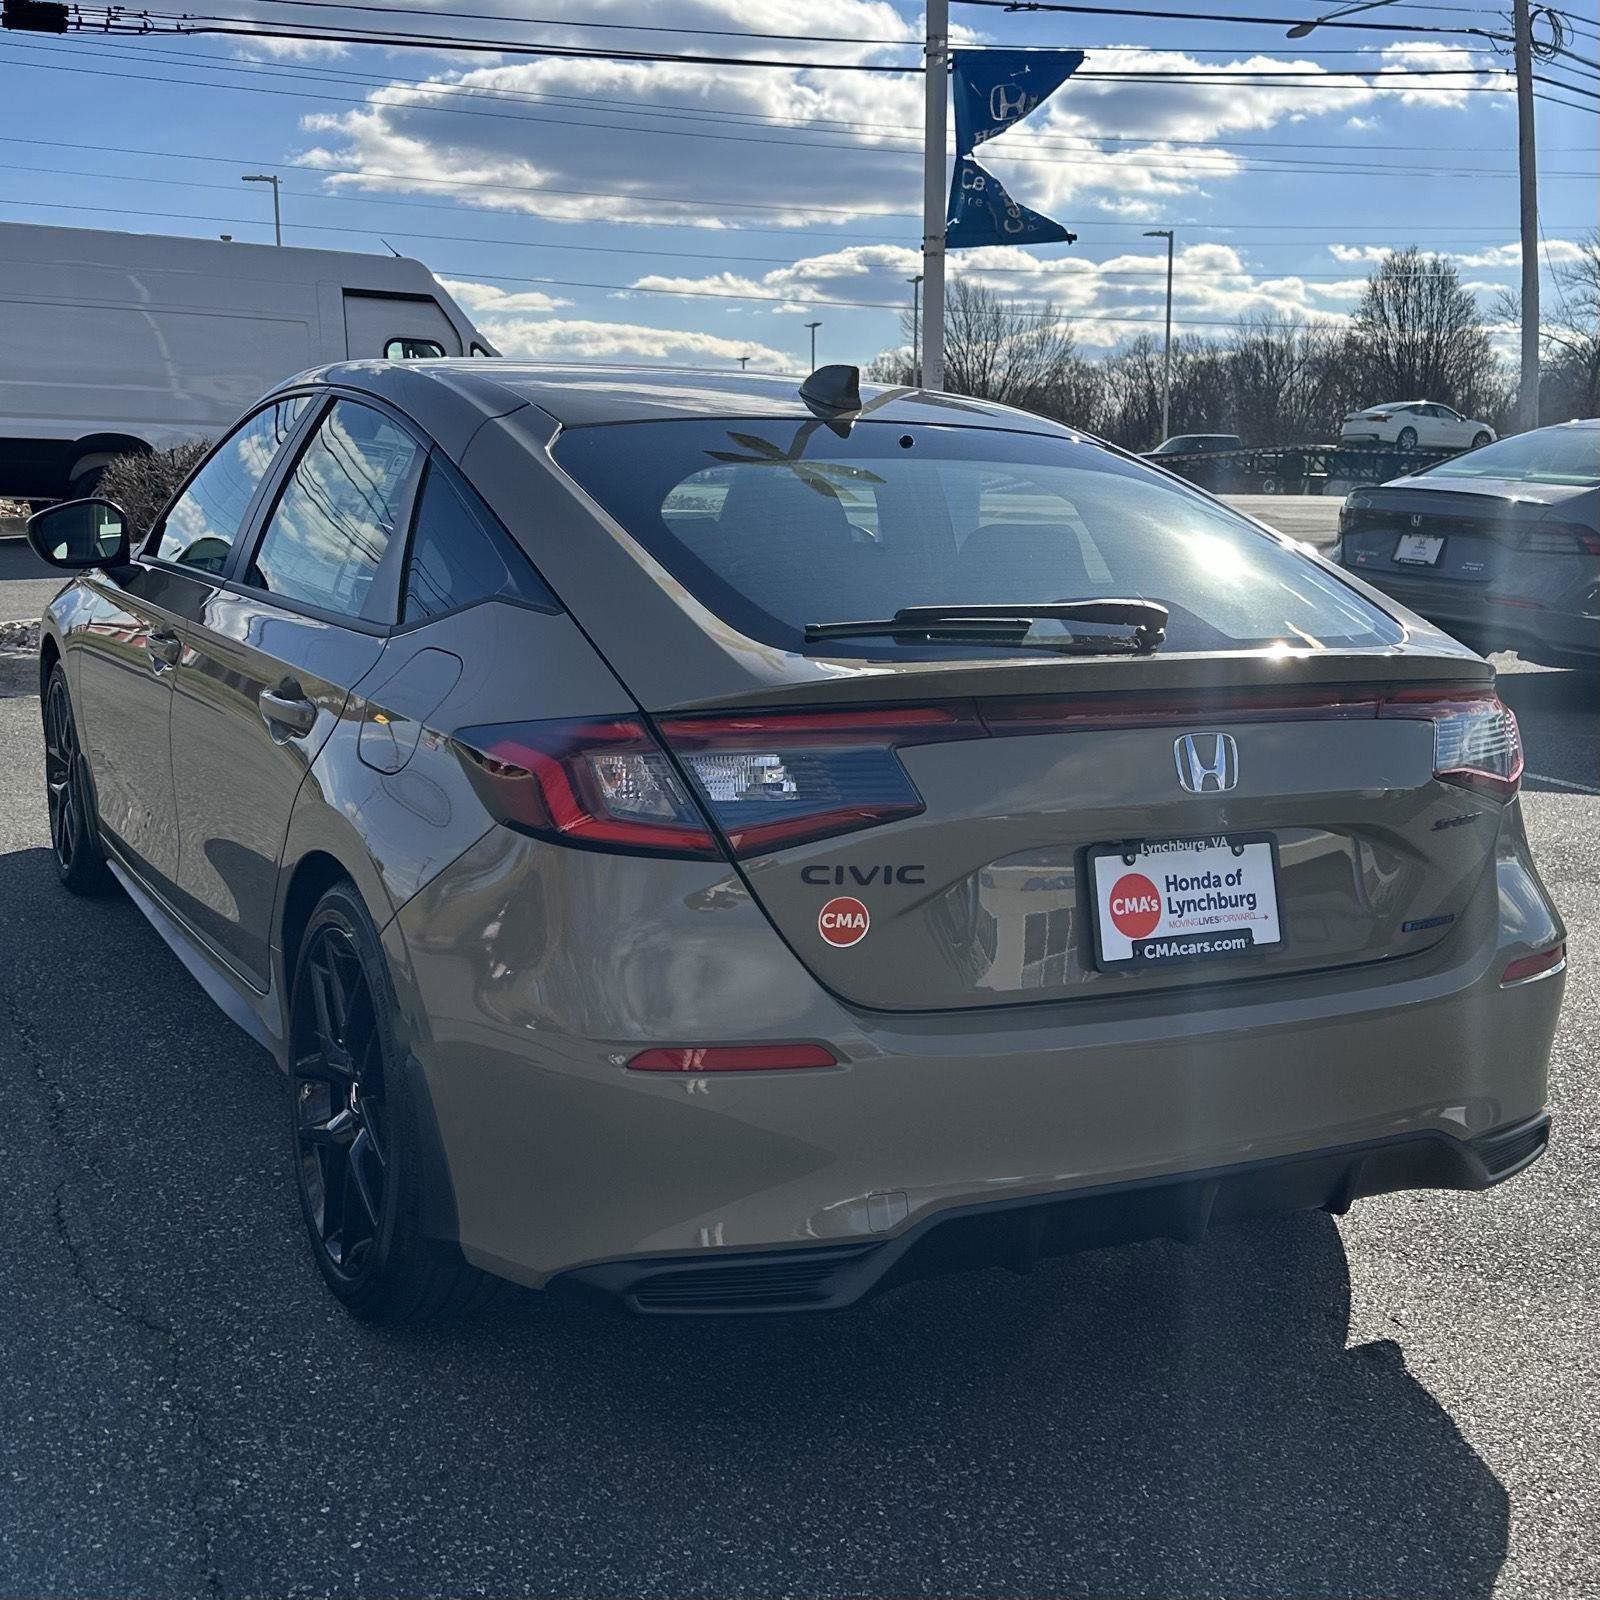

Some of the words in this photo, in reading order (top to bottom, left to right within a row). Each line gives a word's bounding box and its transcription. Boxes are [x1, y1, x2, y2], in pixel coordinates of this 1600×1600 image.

[1140, 839, 1208, 857] Lynchburg,
[1211, 836, 1228, 848] VA
[801, 864, 925, 886] CIVIC
[1165, 871, 1222, 893] Honda
[1224, 868, 1243, 886] of
[1112, 895, 1159, 916] CMA's
[1167, 891, 1258, 918] Lynchburg
[821, 913, 866, 929] CMA
[1143, 937, 1246, 959] CMAcars.com
